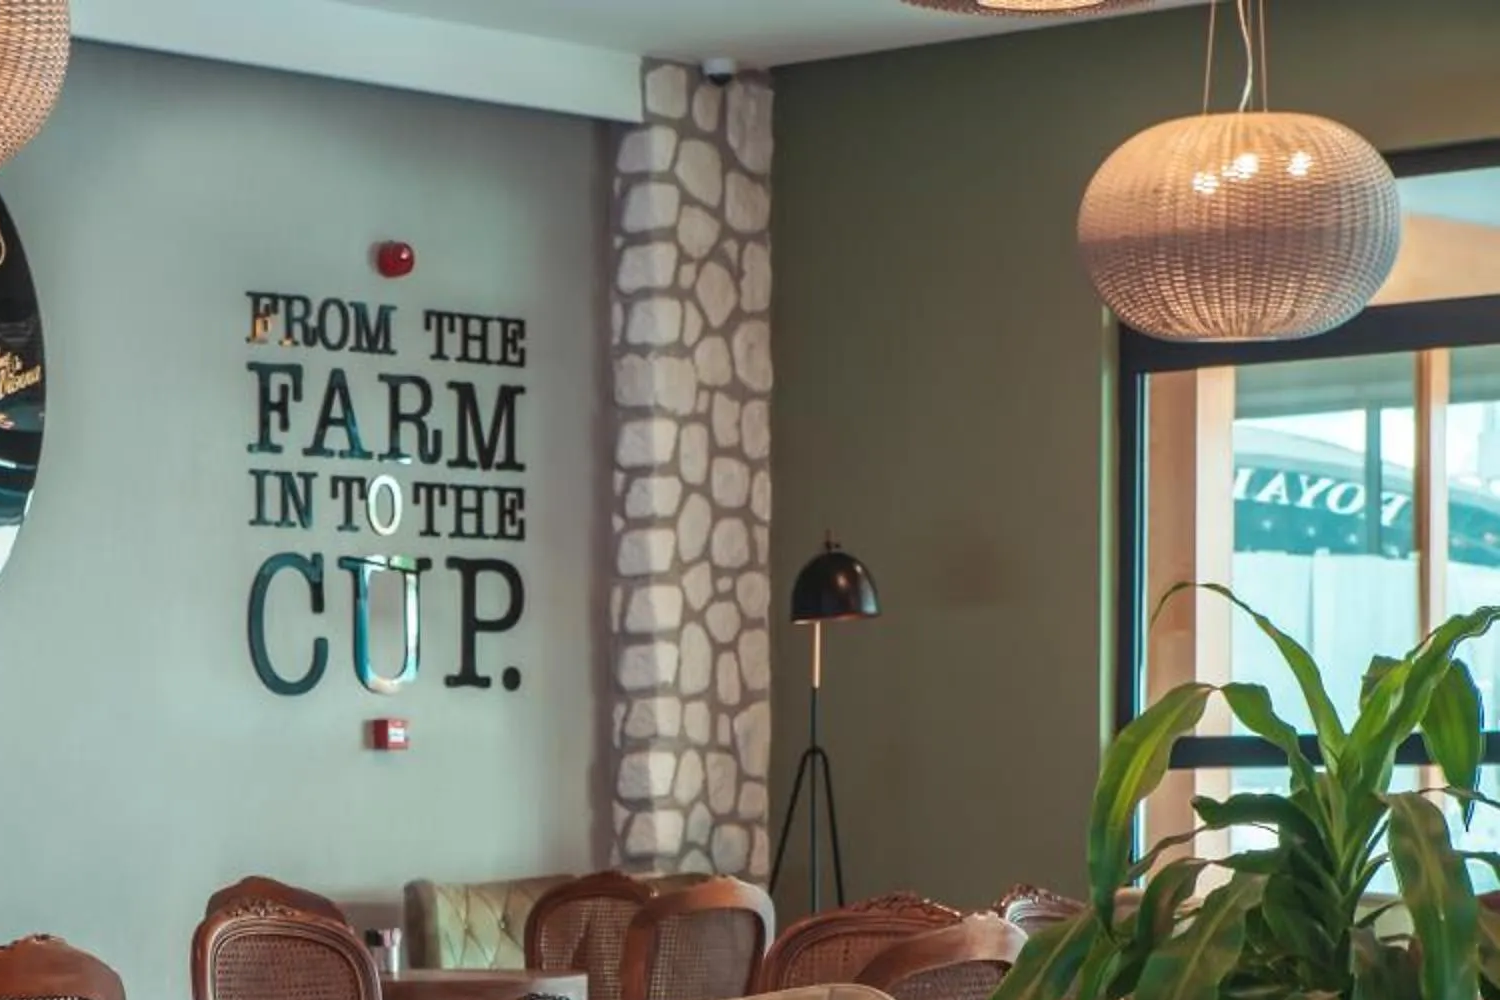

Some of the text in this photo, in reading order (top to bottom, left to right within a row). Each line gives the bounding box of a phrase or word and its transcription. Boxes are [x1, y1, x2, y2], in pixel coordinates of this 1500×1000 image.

[245, 291, 526, 368] FROM THE
[246, 362, 526, 472] FARM
[248, 469, 526, 541] IN TO THE
[247, 551, 526, 696] CUP.
